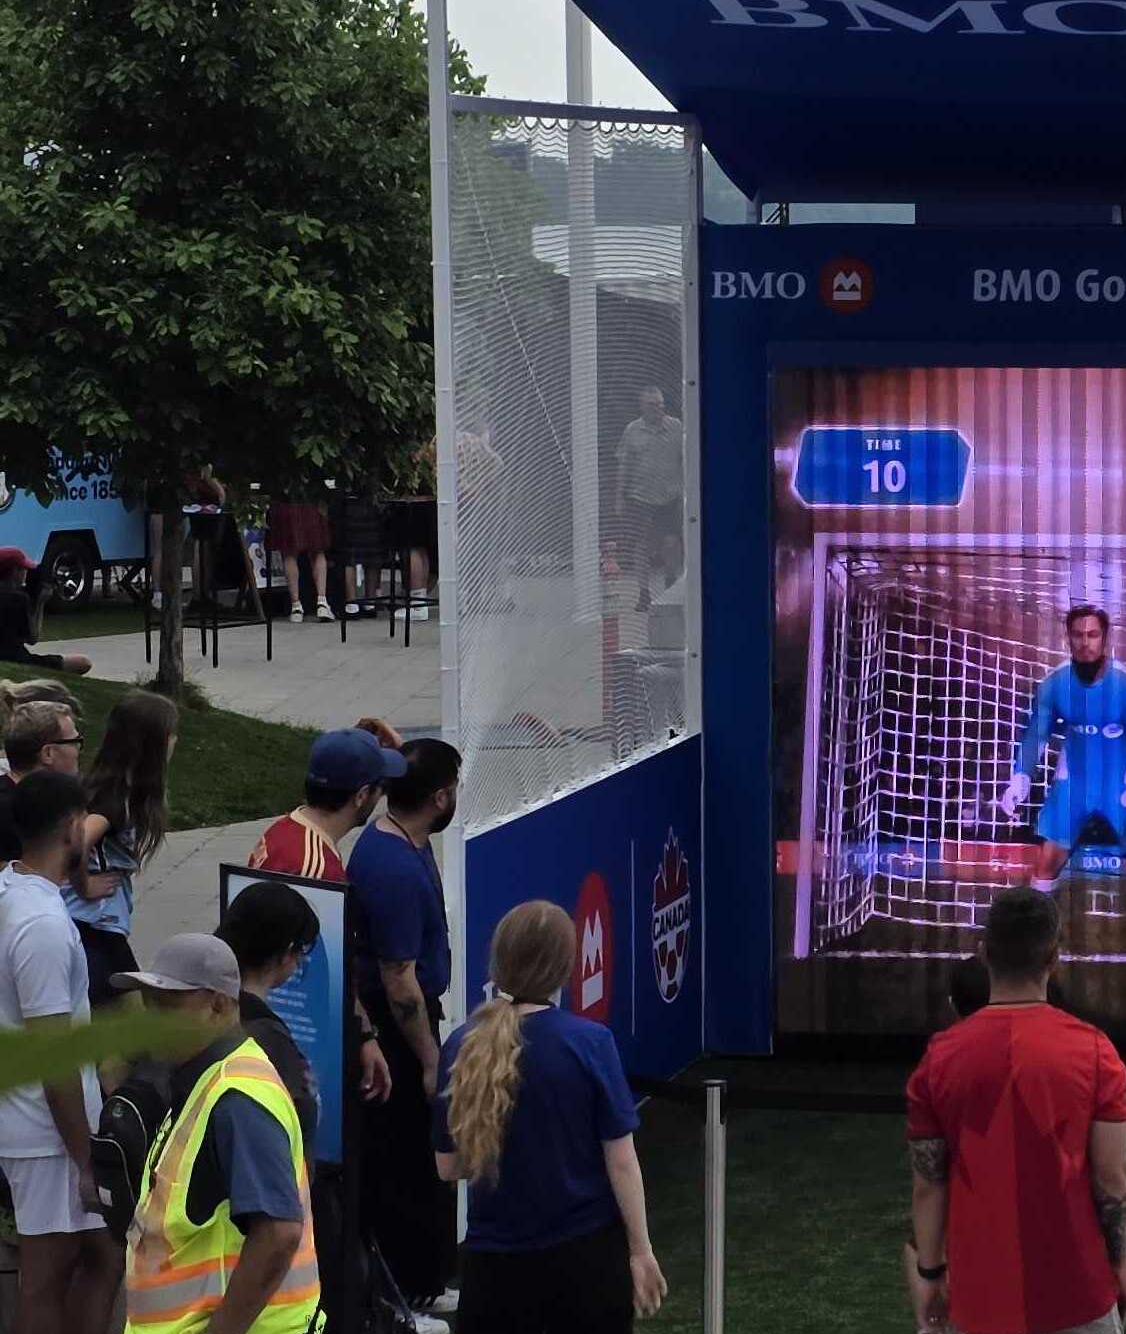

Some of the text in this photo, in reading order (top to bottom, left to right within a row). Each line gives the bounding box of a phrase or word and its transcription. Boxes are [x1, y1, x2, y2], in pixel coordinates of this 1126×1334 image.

[711, 270, 806, 300] BMO
[973, 269, 1061, 302] BMO
[866, 439, 901, 451] TIME
[863, 459, 906, 493] 10
[1083, 856, 1121, 868] BMO
